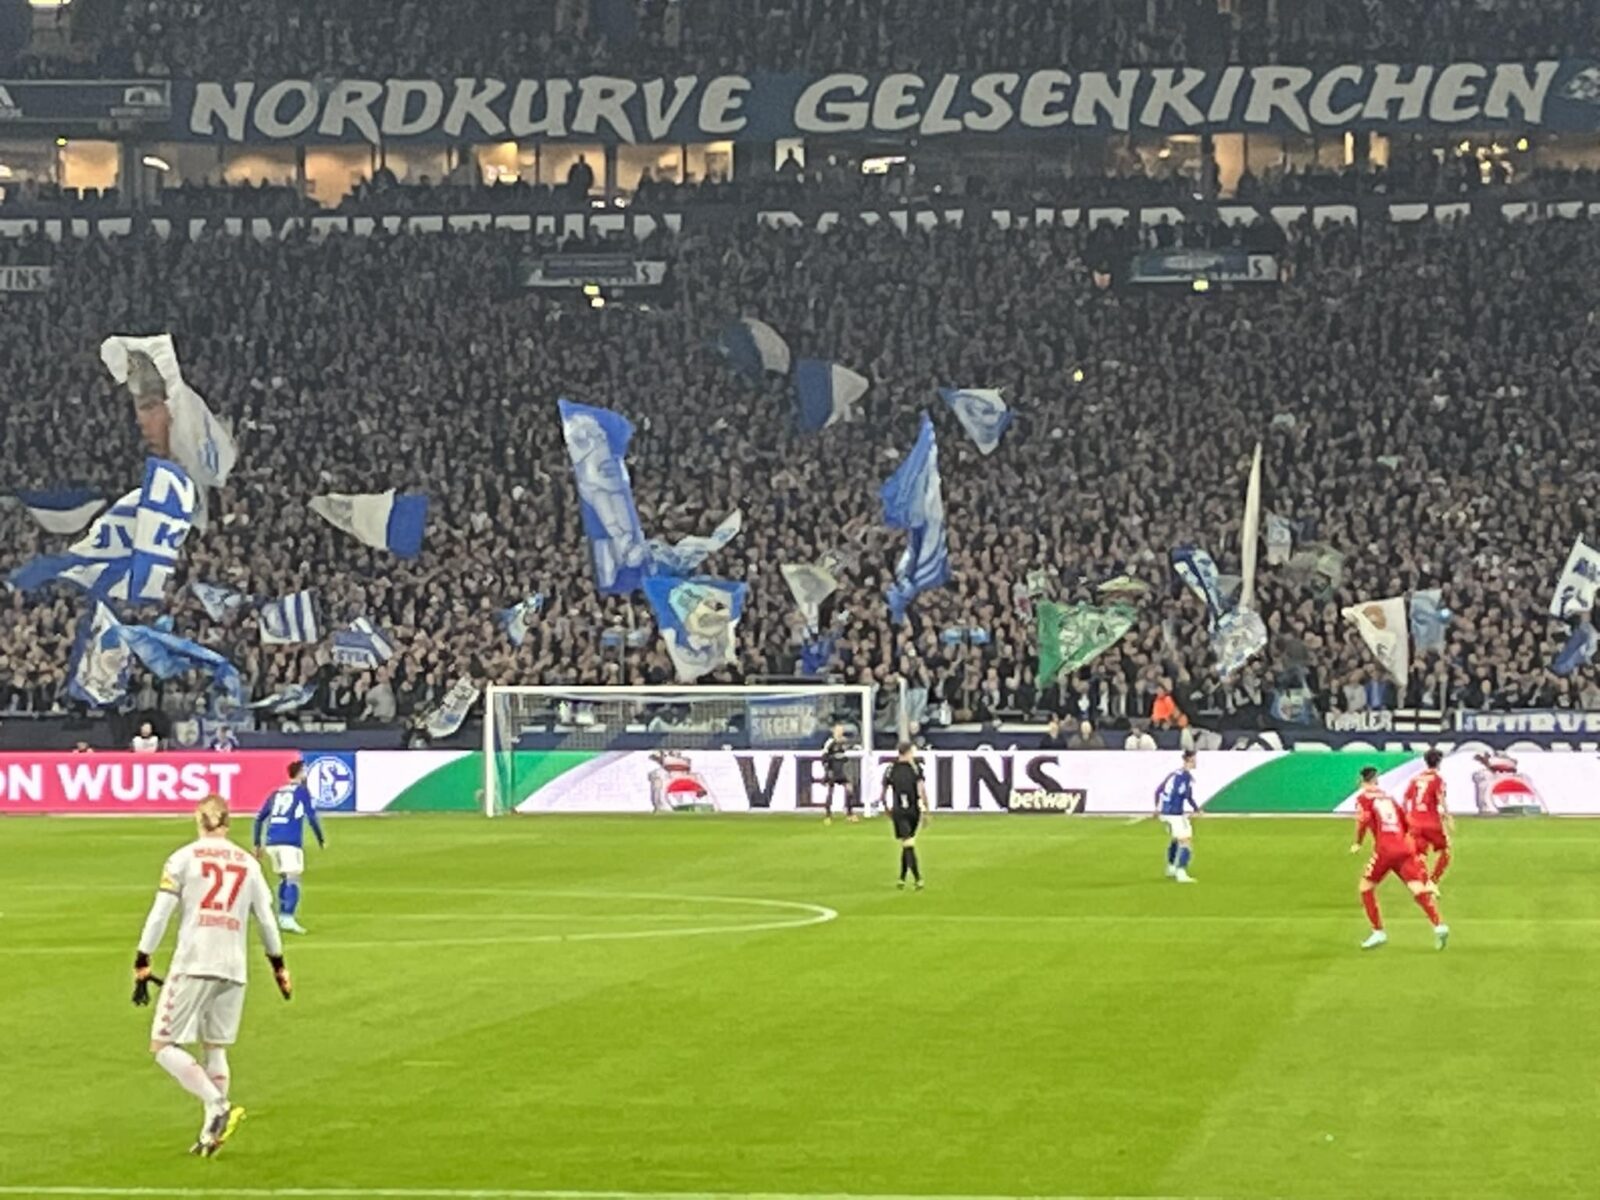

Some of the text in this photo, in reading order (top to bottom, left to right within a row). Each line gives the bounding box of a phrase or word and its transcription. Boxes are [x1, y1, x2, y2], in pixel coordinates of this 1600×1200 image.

[189, 61, 1560, 144] NORDKURVE GELSENKIRCHEN
[0, 763, 241, 801] N WURST
[1009, 788, 1081, 815] betway
[200, 862, 249, 912] 27
